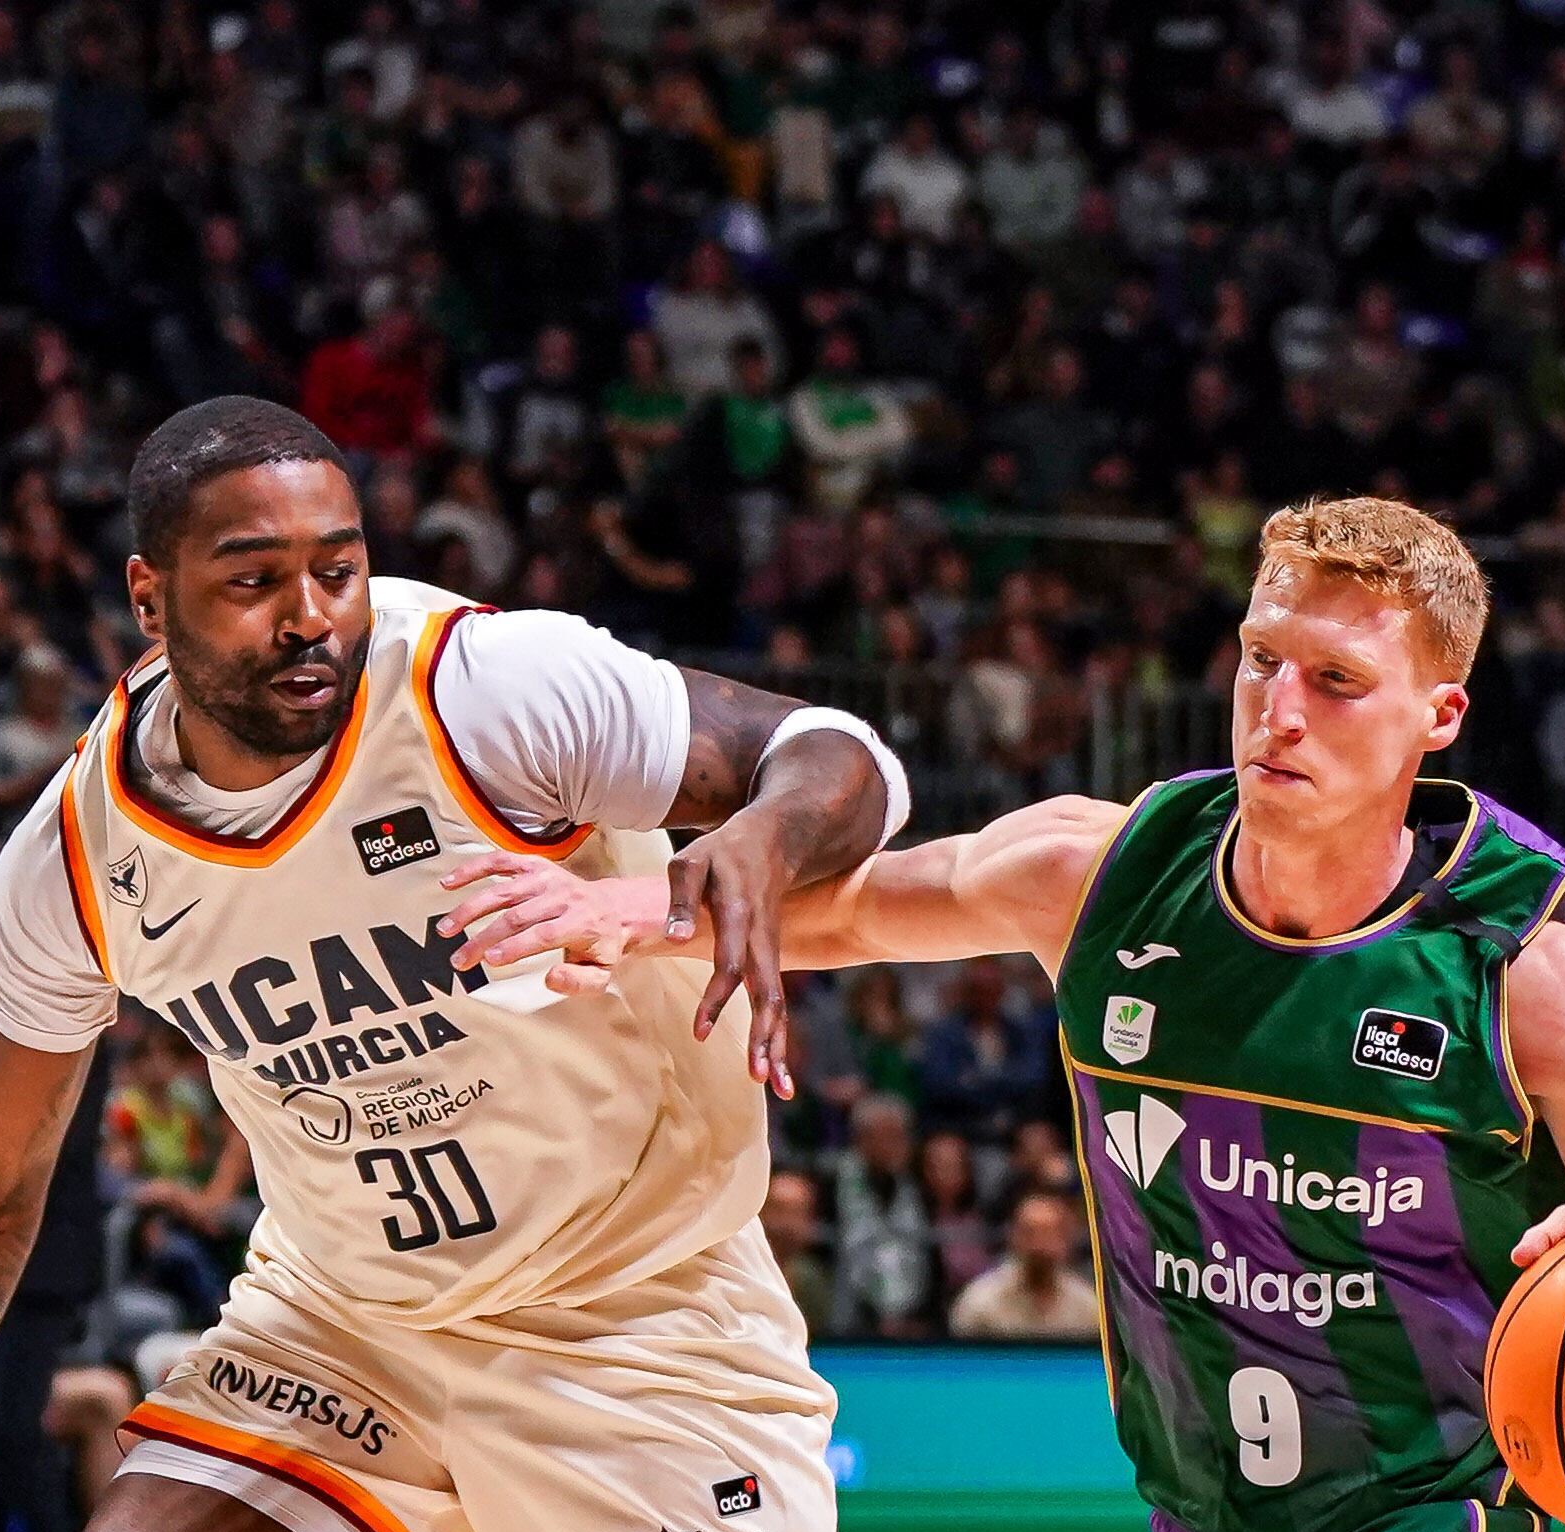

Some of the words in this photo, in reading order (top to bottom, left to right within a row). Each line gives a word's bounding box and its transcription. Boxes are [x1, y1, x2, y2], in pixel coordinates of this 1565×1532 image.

[361, 834, 396, 855] liga
[369, 839, 436, 869] endesa
[166, 912, 490, 1062] UCAM
[252, 1010, 469, 1090] MURCIA
[1362, 1044, 1434, 1072] endesa
[1365, 1025, 1400, 1047] liga
[362, 1083, 450, 1121] REGIÓN
[369, 1117, 402, 1140] DE
[406, 1078, 494, 1130] MURCIA
[354, 1138, 498, 1253] 30
[1199, 1138, 1424, 1227] Unicaja
[1155, 1241, 1377, 1328] málaga
[209, 1356, 392, 1456] INVERSUS
[1228, 1366, 1302, 1487] 9
[720, 1491, 752, 1513] acb
